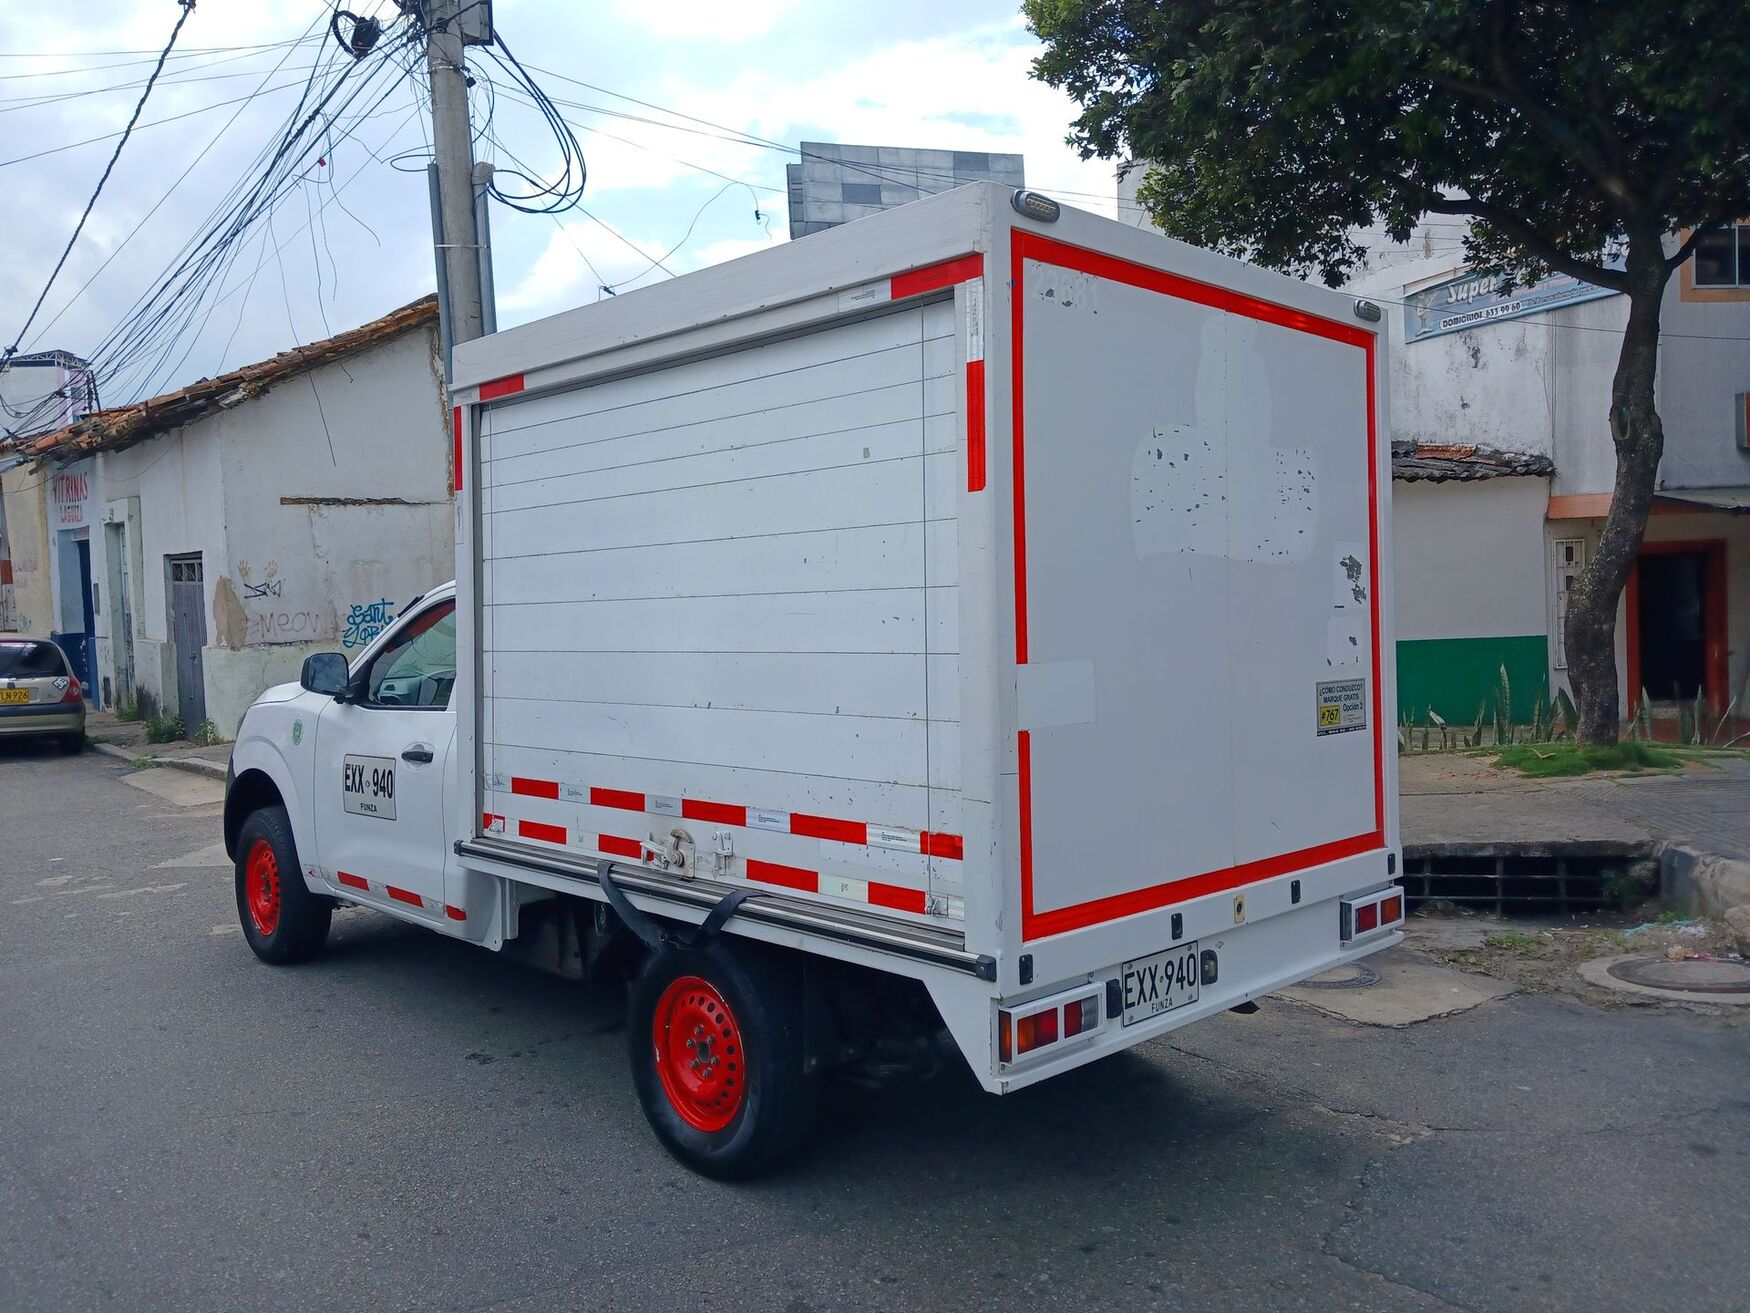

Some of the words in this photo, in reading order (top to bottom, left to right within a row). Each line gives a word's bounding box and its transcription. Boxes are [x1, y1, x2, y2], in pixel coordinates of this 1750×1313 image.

[1447, 276, 1497, 304] Super
[1443, 314, 1483, 328] DOMICILIOS
[1486, 306, 1499, 318] 633
[1500, 304, 1510, 314] 99
[1512, 302, 1521, 312] 60
[53, 472, 88, 504] VITRINAS
[1323, 695, 1342, 704] MARQUE
[360, 802, 378, 813] FUNZA
[1151, 997, 1173, 1013] FUNZA
